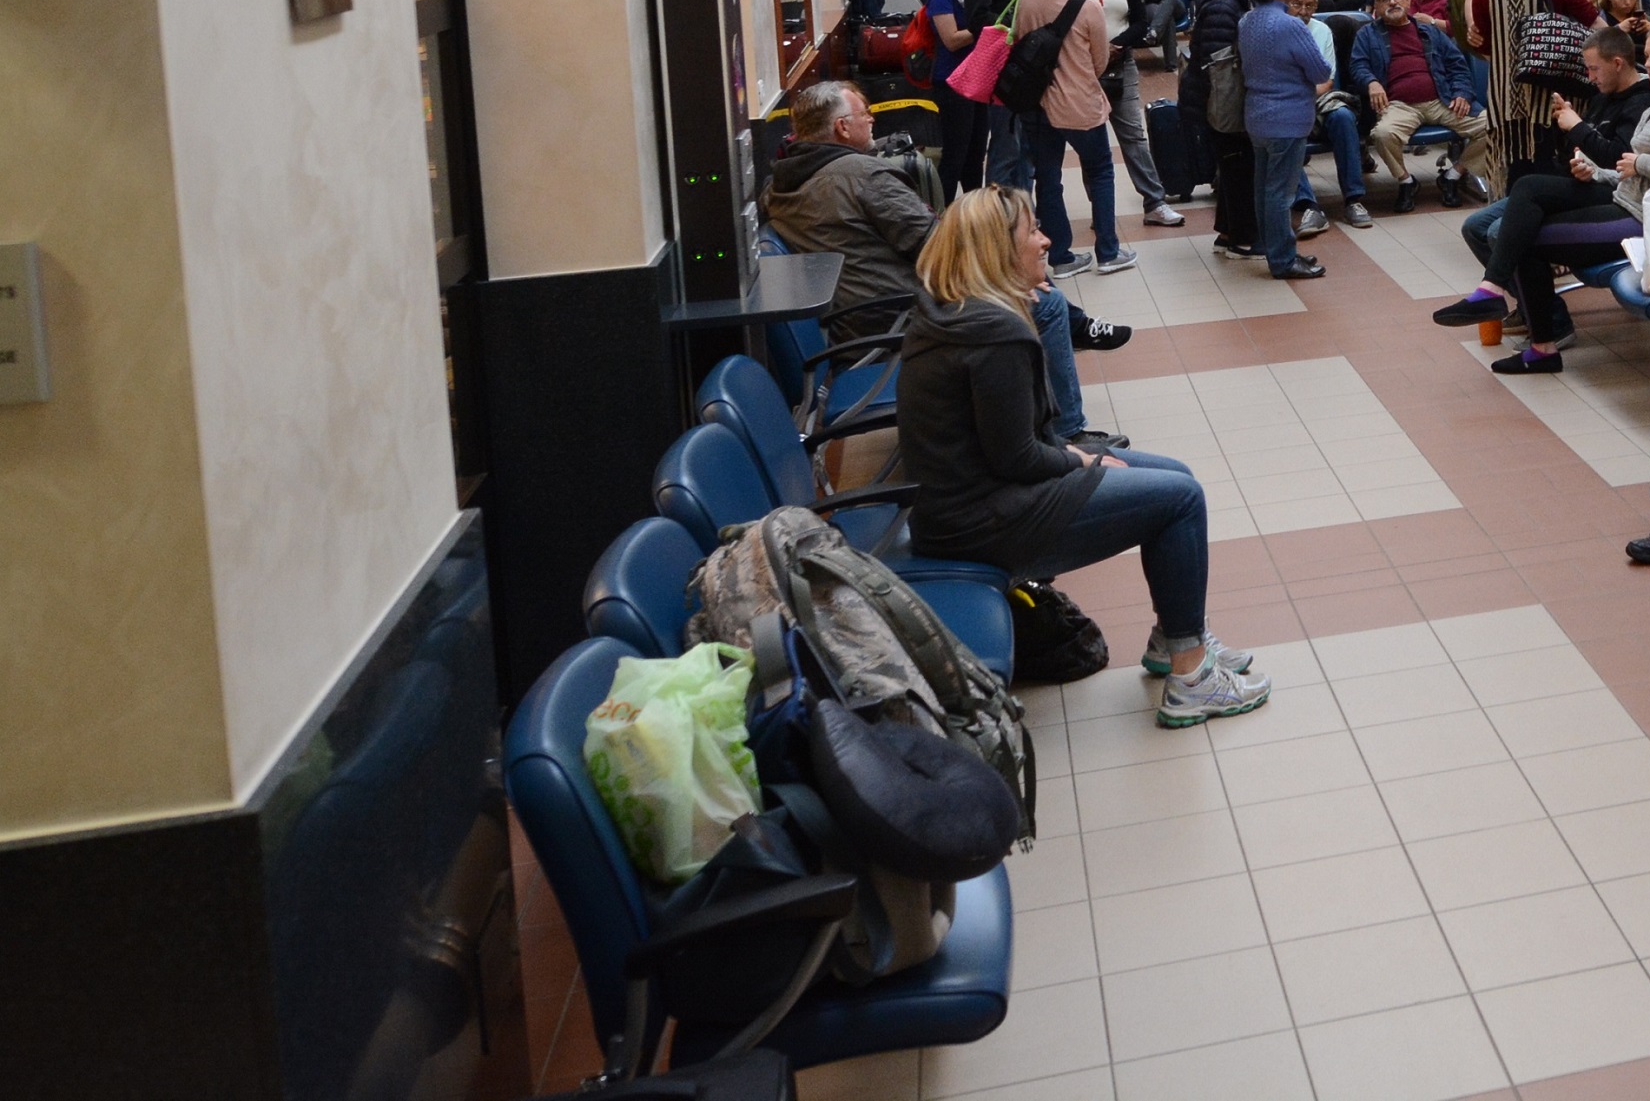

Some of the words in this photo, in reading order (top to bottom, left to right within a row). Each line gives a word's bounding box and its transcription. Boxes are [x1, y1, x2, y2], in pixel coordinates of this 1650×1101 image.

[1542, 20, 1570, 28] EUROPE
[1540, 36, 1570, 44] EUROPE
[1540, 51, 1568, 60] EUROPE
